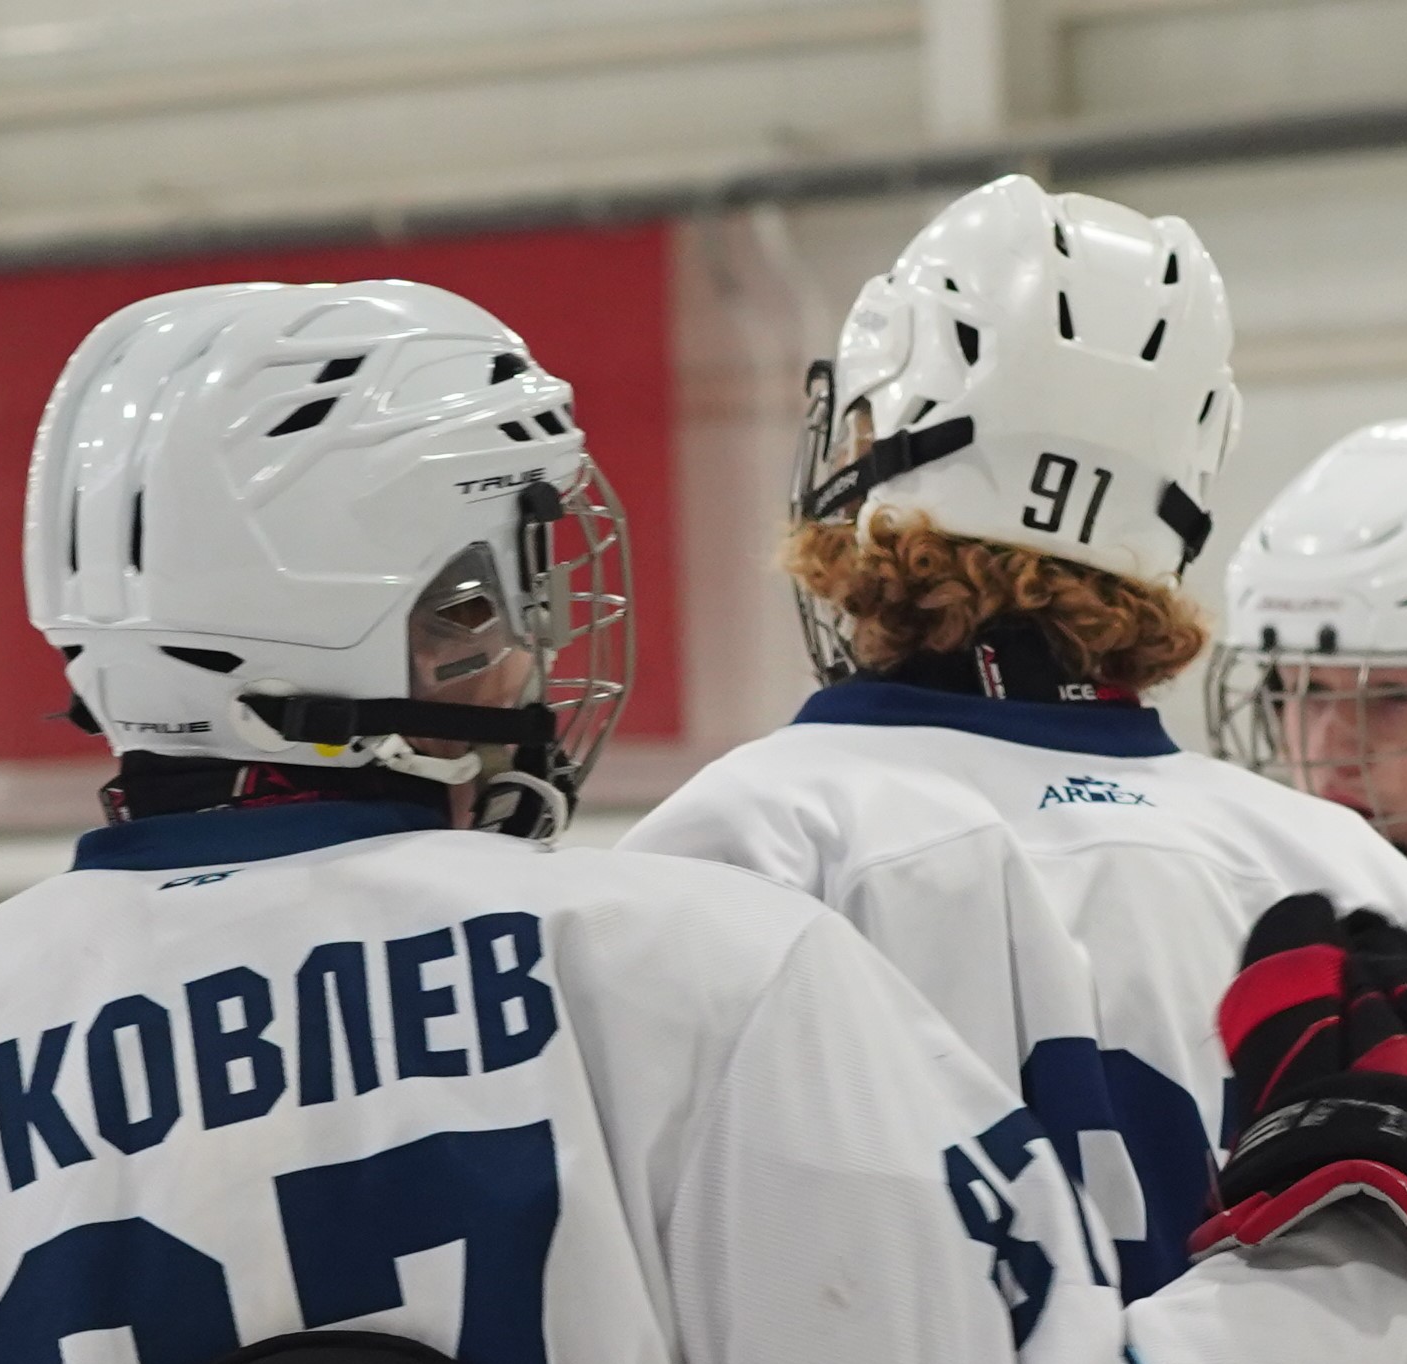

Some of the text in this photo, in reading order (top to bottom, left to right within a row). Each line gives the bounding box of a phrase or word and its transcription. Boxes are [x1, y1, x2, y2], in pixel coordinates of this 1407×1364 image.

[453, 467, 547, 495] TRUE
[1022, 452, 1113, 545] 91
[114, 720, 213, 734] TRUE
